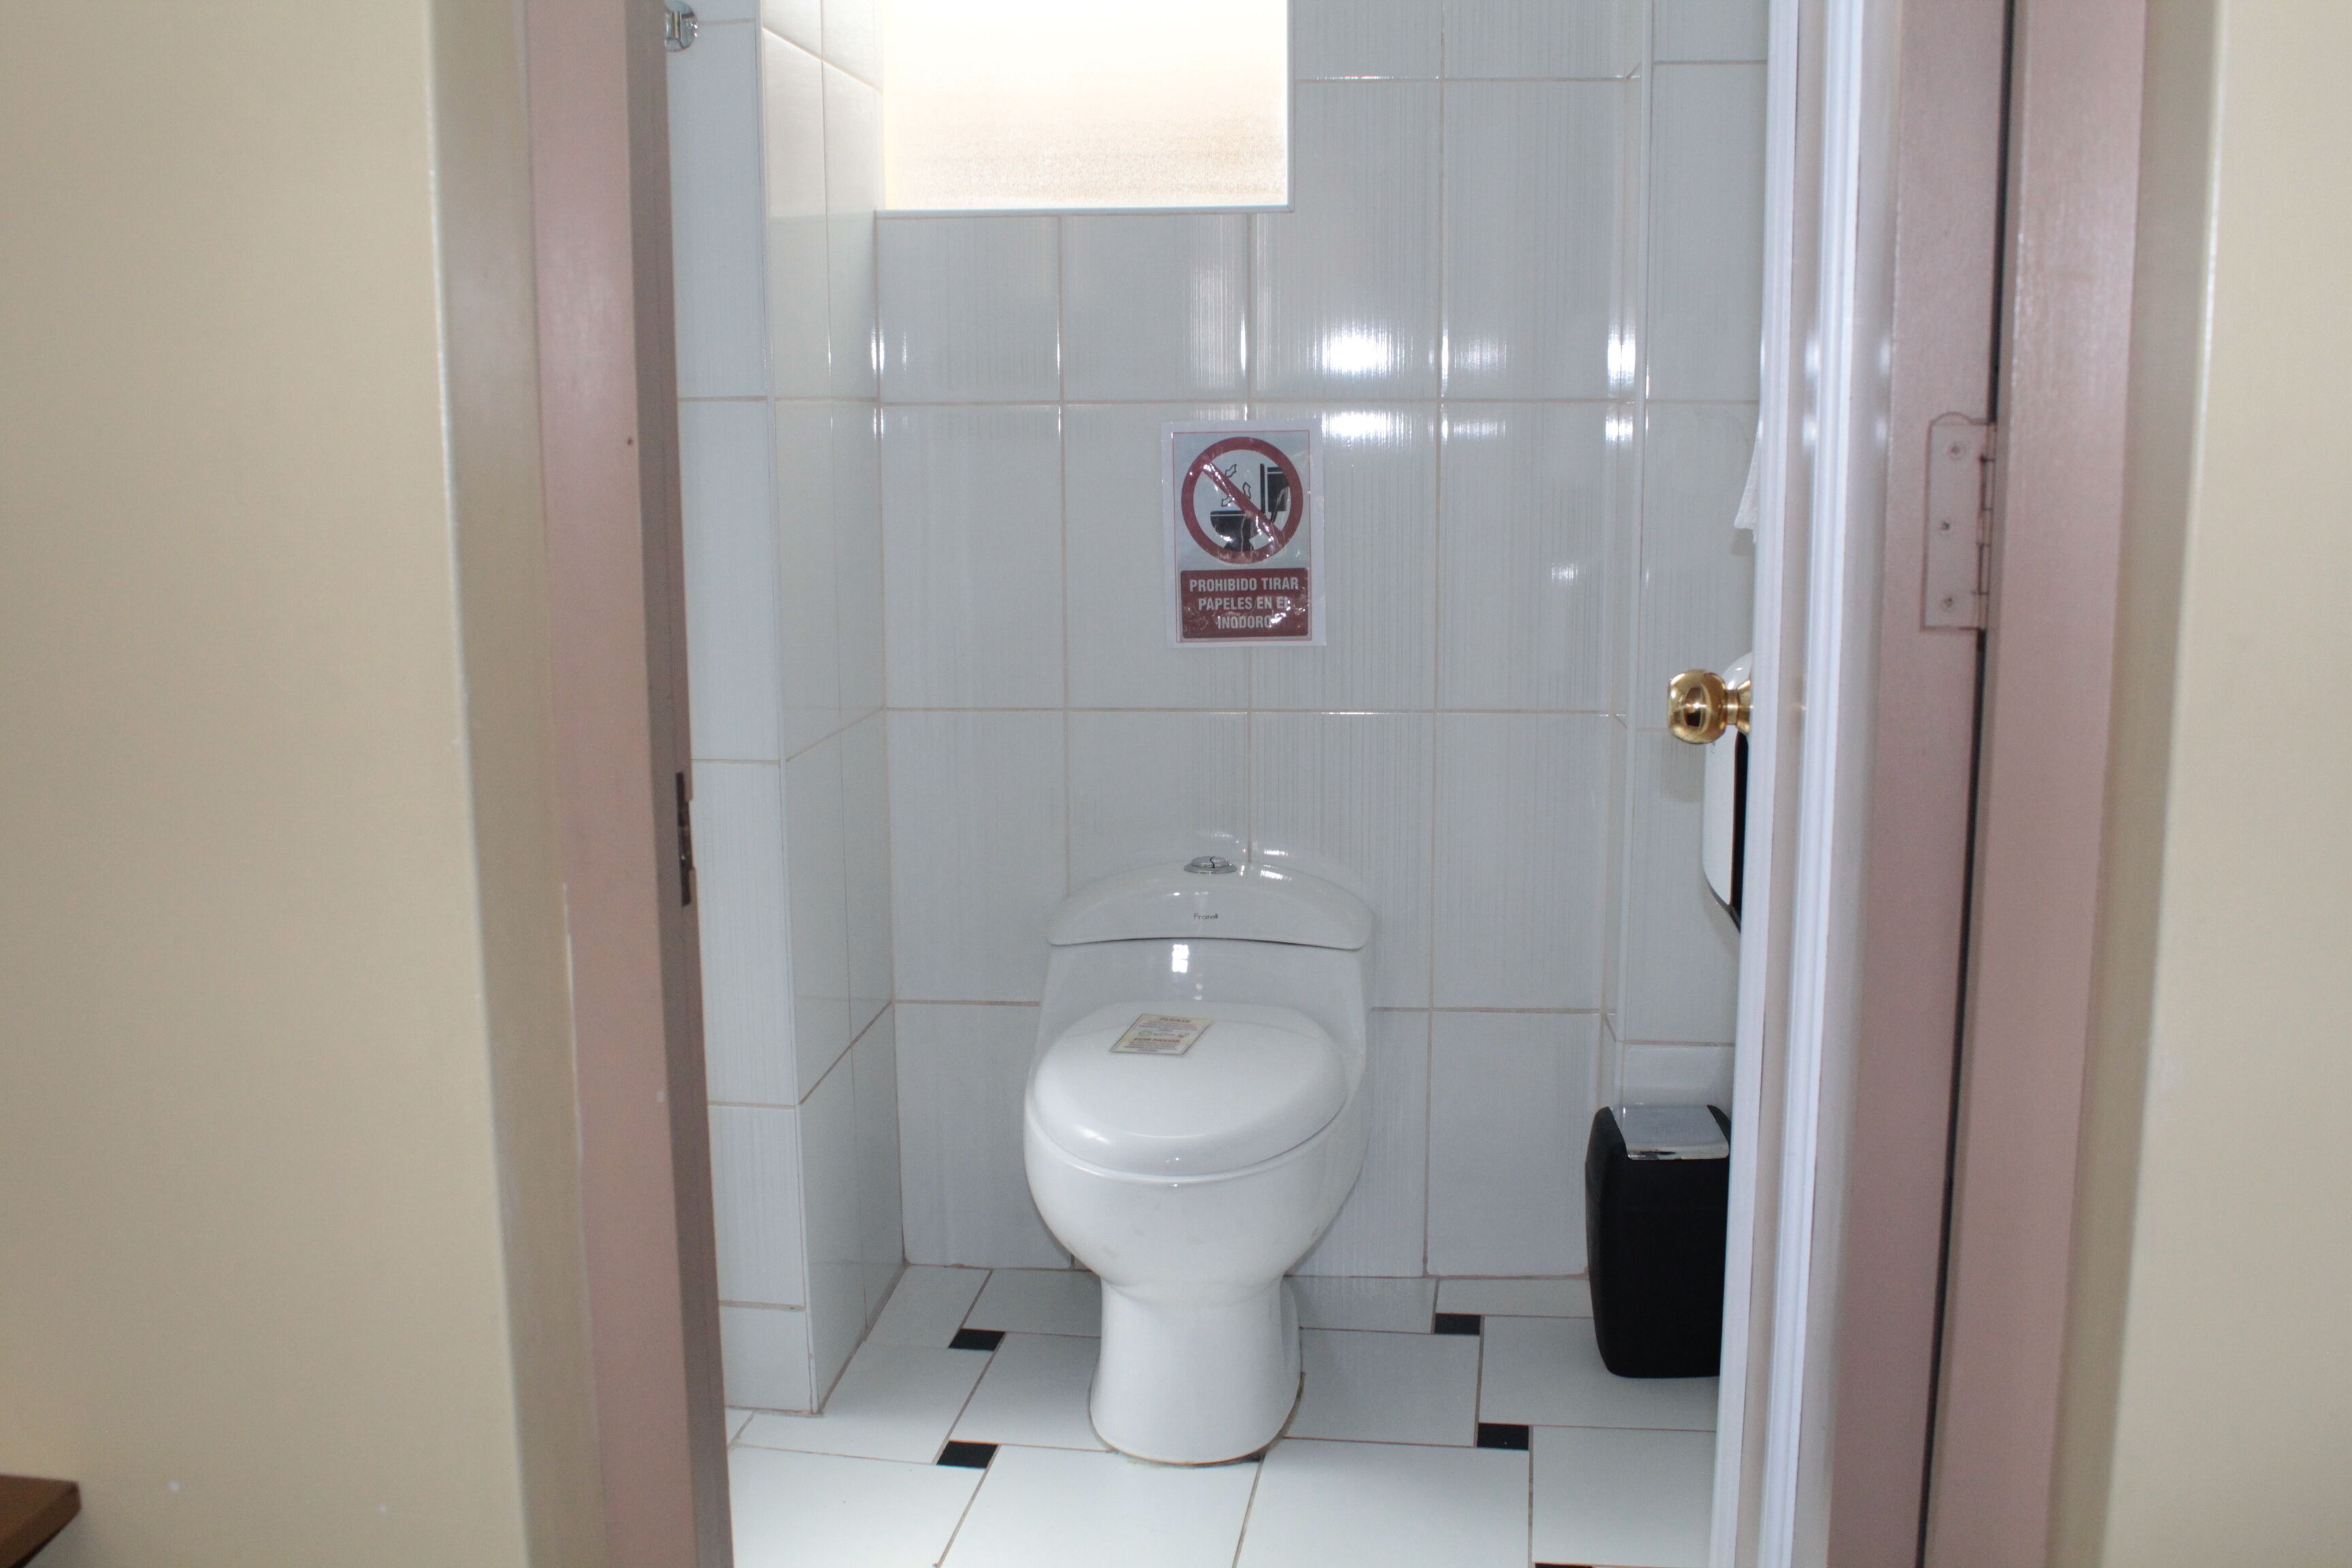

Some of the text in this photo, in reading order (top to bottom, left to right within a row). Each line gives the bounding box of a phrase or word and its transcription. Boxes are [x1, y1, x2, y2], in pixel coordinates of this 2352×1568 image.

[1189, 576, 1299, 592] PROHIBIDO TIRAR
[1198, 595, 1291, 611] PAPELES EN EL
